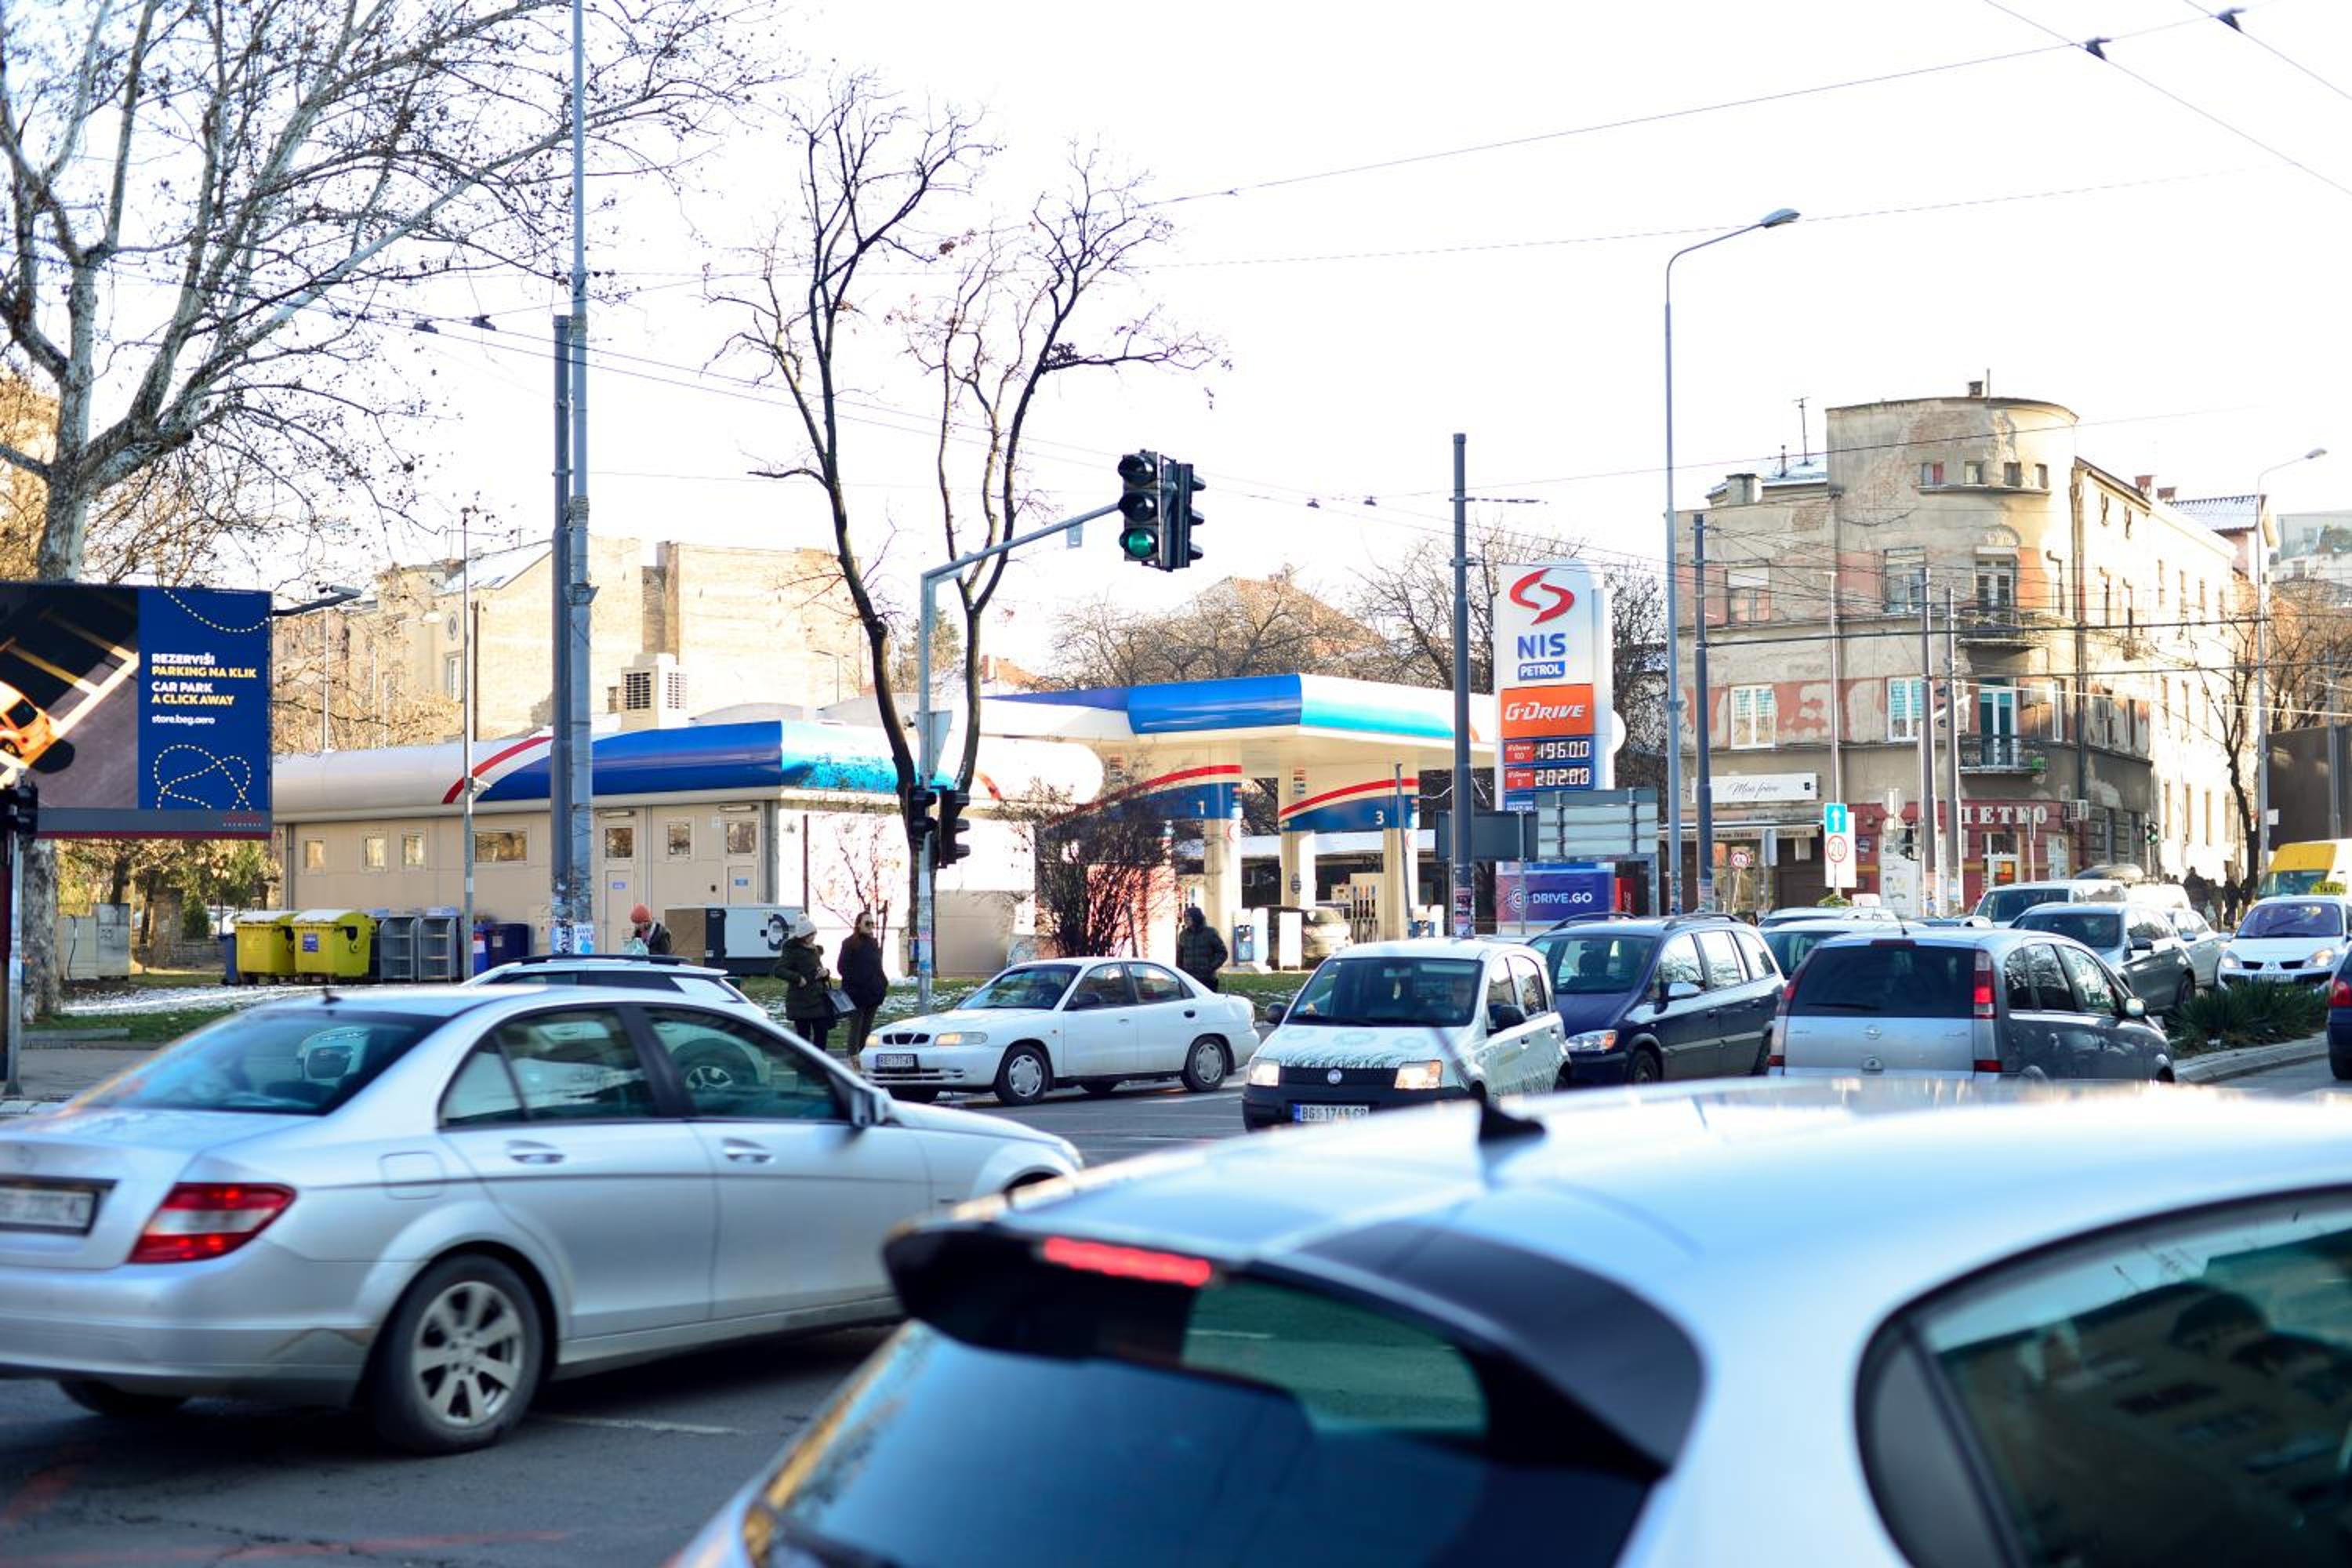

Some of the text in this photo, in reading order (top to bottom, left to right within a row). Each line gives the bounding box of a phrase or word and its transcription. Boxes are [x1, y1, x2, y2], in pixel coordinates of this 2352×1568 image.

[1517, 633, 1566, 659] NIS
[151, 652, 216, 666] REZERVIŠI
[151, 666, 257, 678] PARKING NA KLIK
[1520, 664, 1563, 677] PETROL
[151, 681, 213, 693] CAR PARK
[151, 694, 234, 705] A CLICK AWAY
[1198, 800, 1205, 815] 1
[1375, 811, 1385, 826] 3
[1831, 841, 1842, 857] 20
[1532, 891, 1592, 903] DRIVE.GO
[1302, 1106, 1316, 1120] BG
